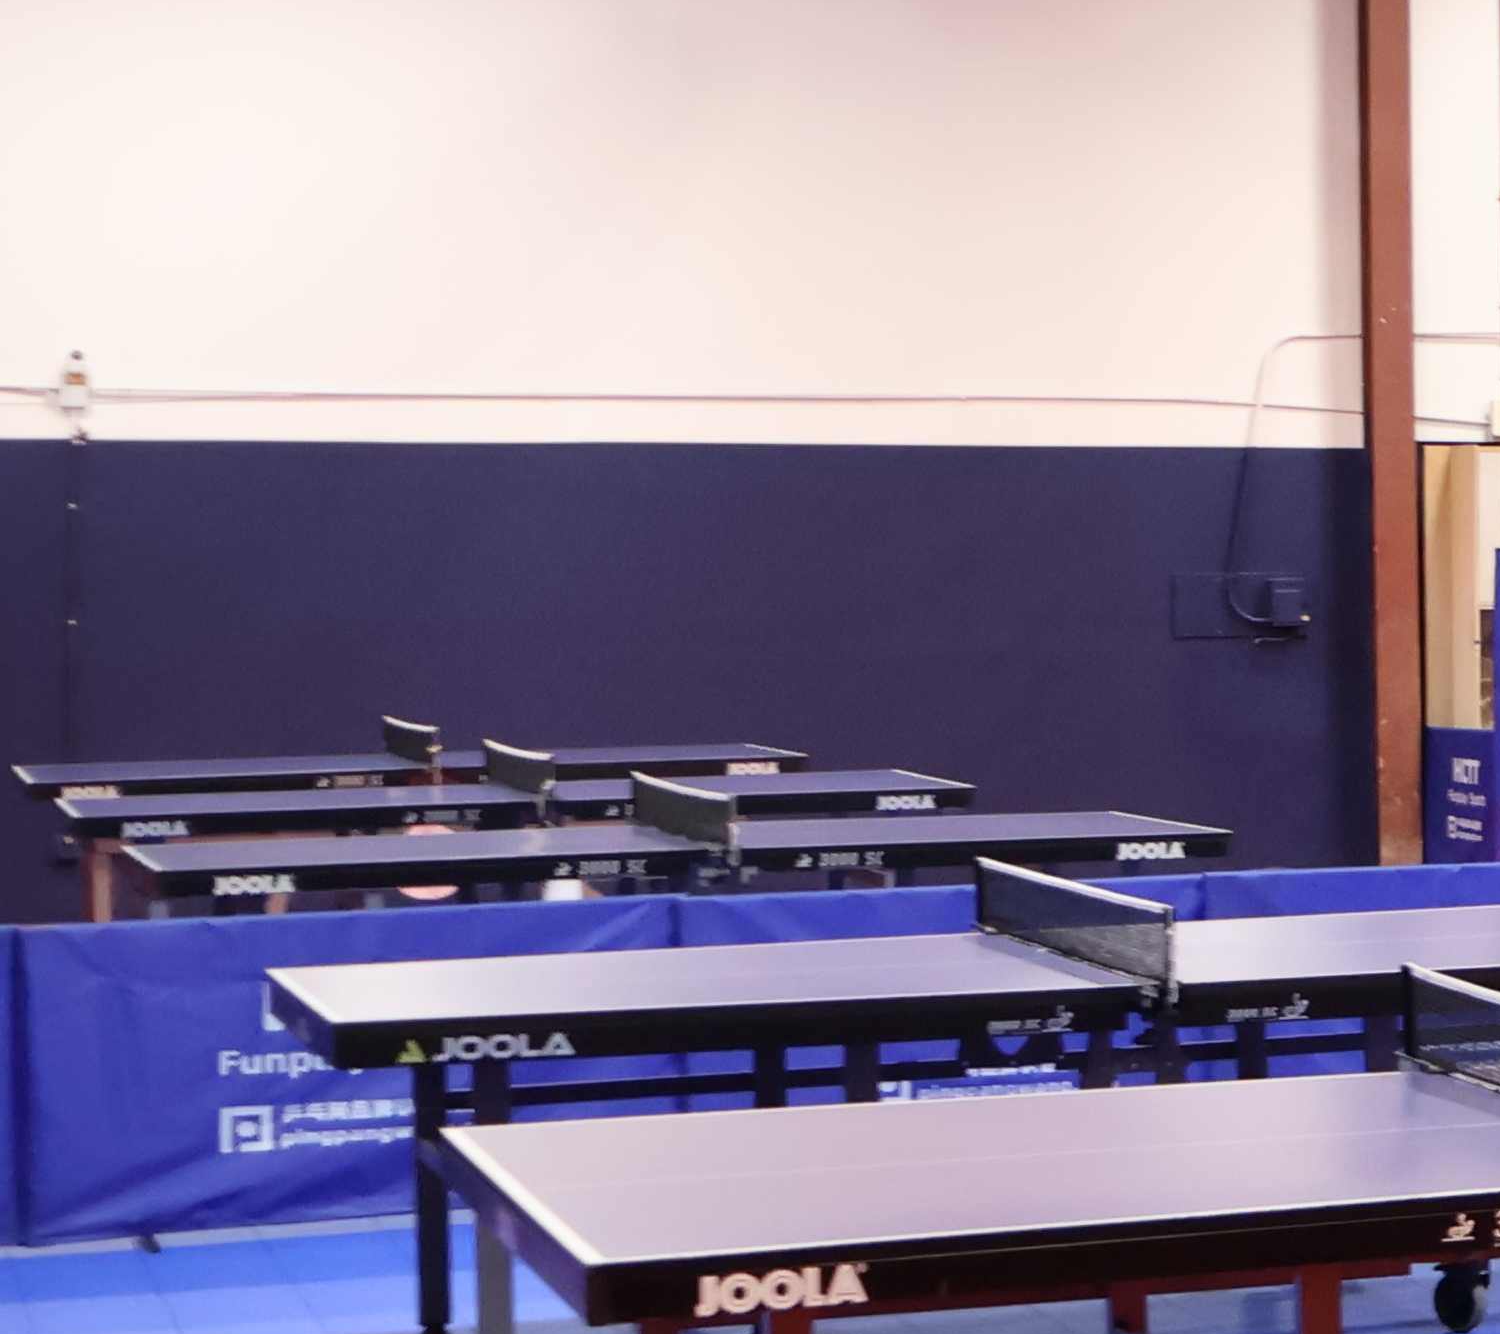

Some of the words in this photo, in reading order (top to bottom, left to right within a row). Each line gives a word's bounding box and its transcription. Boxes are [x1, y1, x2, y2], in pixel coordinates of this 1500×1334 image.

[1115, 841, 1187, 860] JOOLA
[212, 873, 297, 896] JOOLA
[431, 1032, 577, 1062] JOOLA
[693, 1264, 869, 1318] JOOLA
